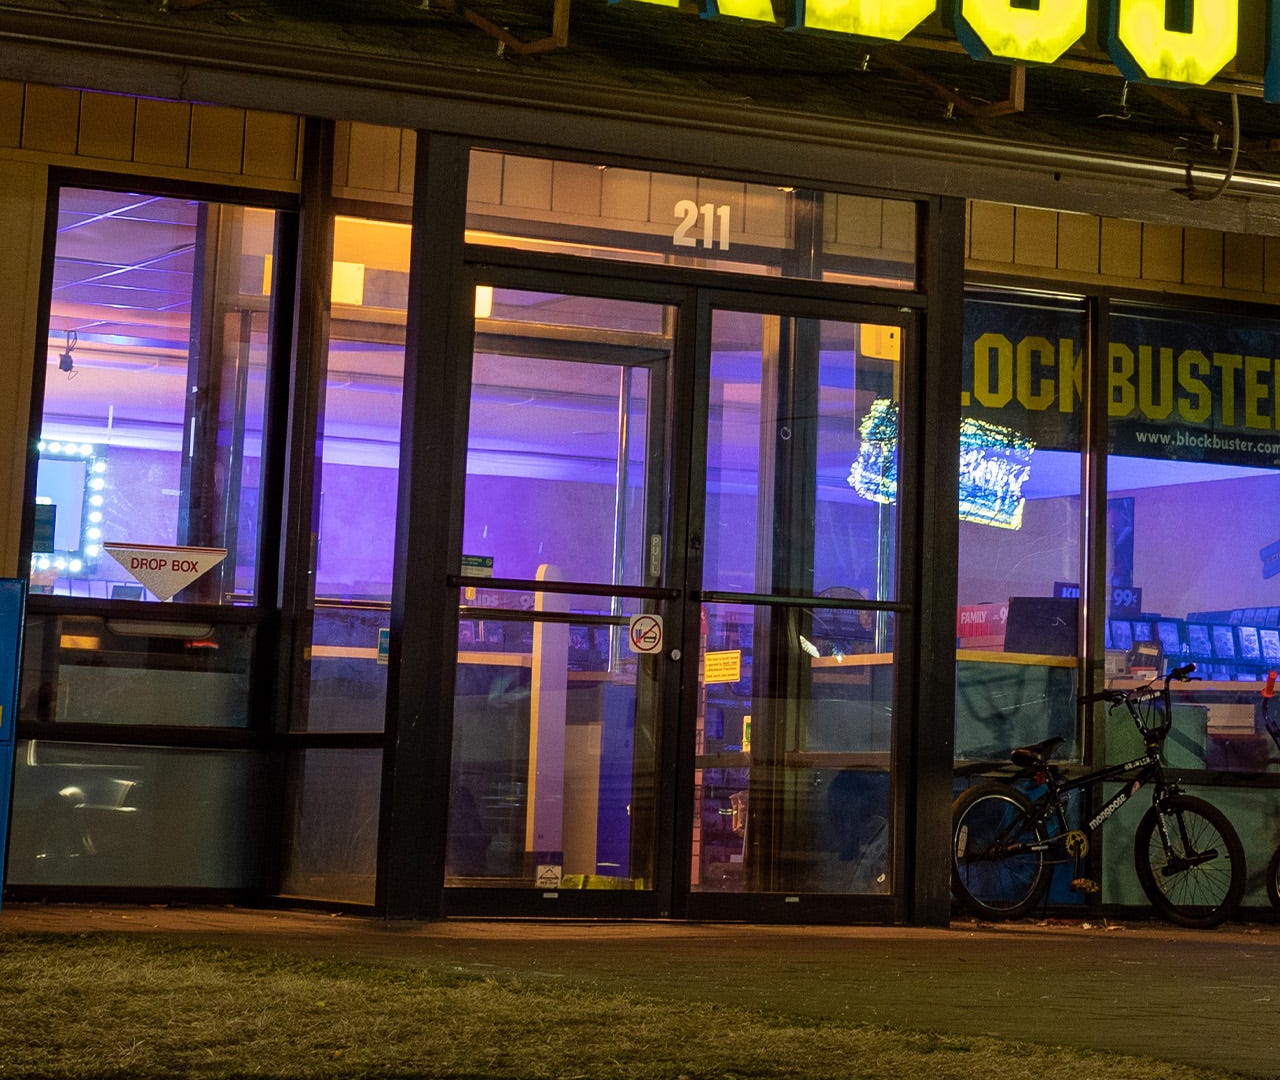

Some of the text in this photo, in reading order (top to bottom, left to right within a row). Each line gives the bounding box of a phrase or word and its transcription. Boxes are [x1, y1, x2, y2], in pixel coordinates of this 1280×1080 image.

[673, 200, 730, 251] 211
[131, 557, 199, 573] DROP BOX
[960, 610, 987, 624] FAMILY
